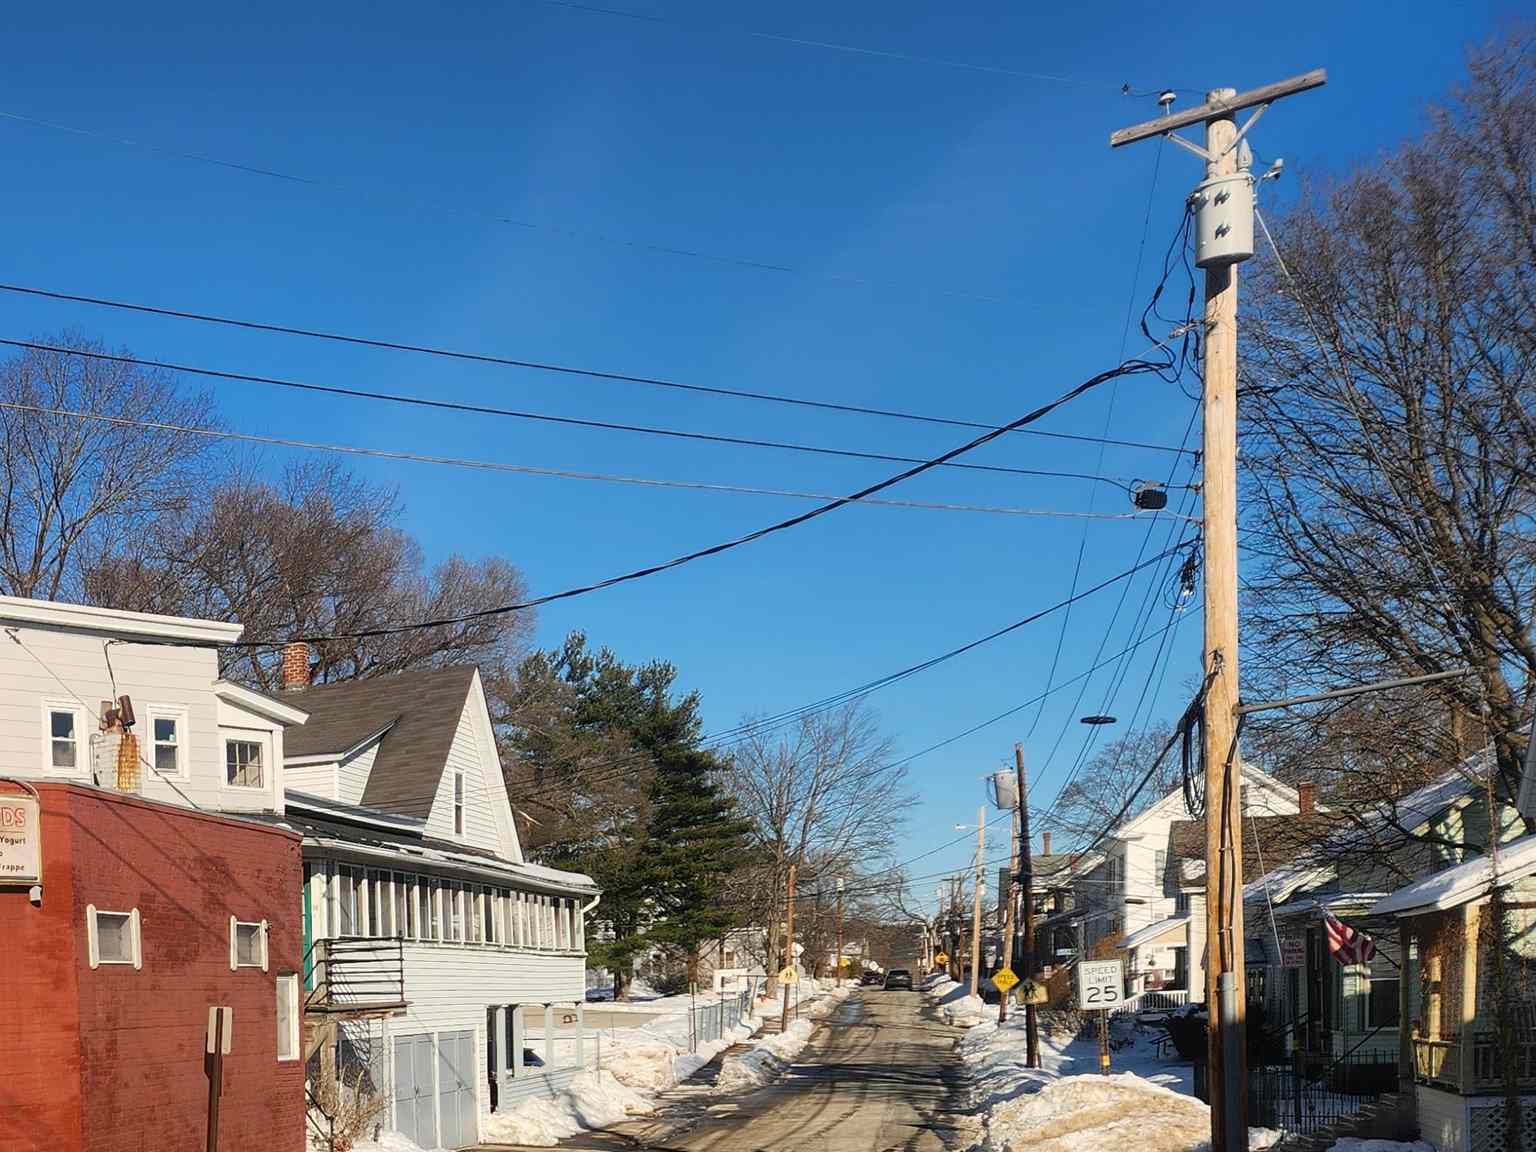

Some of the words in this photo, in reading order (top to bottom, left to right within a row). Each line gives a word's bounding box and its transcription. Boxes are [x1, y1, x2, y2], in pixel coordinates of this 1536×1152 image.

[0, 836, 26, 846] Yogurt
[1084, 966, 1118, 975] SPEED
[1088, 975, 1114, 985] LIMIT
[1087, 986, 1118, 1003] 25
